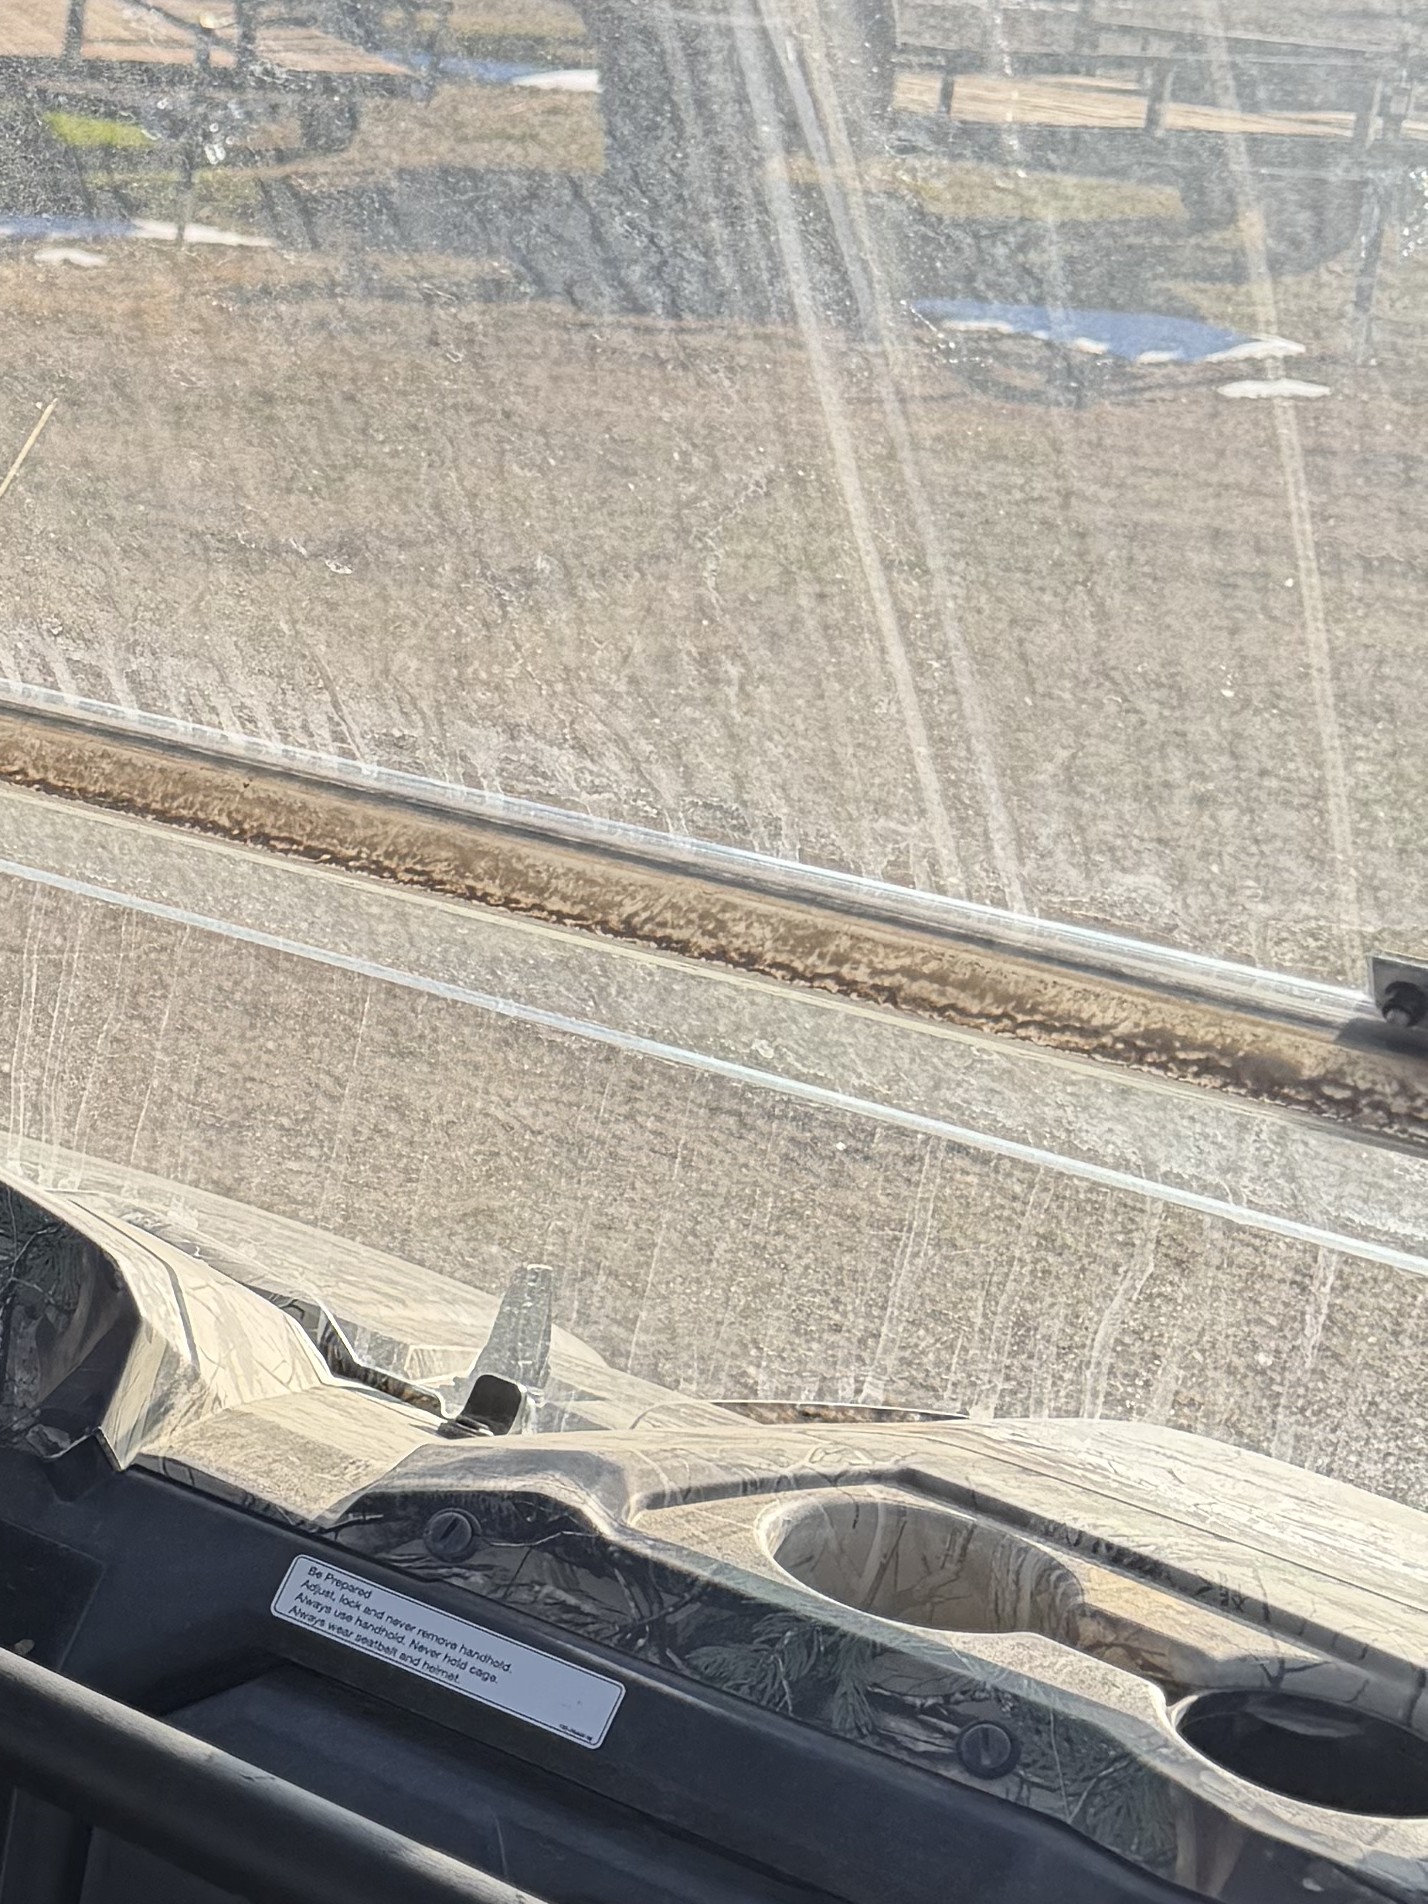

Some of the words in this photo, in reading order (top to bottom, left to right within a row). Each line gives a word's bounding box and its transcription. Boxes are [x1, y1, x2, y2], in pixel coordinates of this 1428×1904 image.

[307, 1566, 324, 1579] Be
[322, 1573, 372, 1601] Prepared
[287, 1604, 326, 1629] Always
[326, 1622, 353, 1638] wear
[354, 1632, 397, 1656] seatbelt
[398, 1650, 420, 1666] and
[293, 1591, 333, 1616] Always
[332, 1609, 353, 1623] use
[408, 1639, 442, 1659] Never
[442, 1653, 467, 1670] hold
[337, 1594, 362, 1610] lock
[362, 1604, 384, 1620] and
[384, 1615, 415, 1633] never
[416, 1628, 457, 1650] remove
